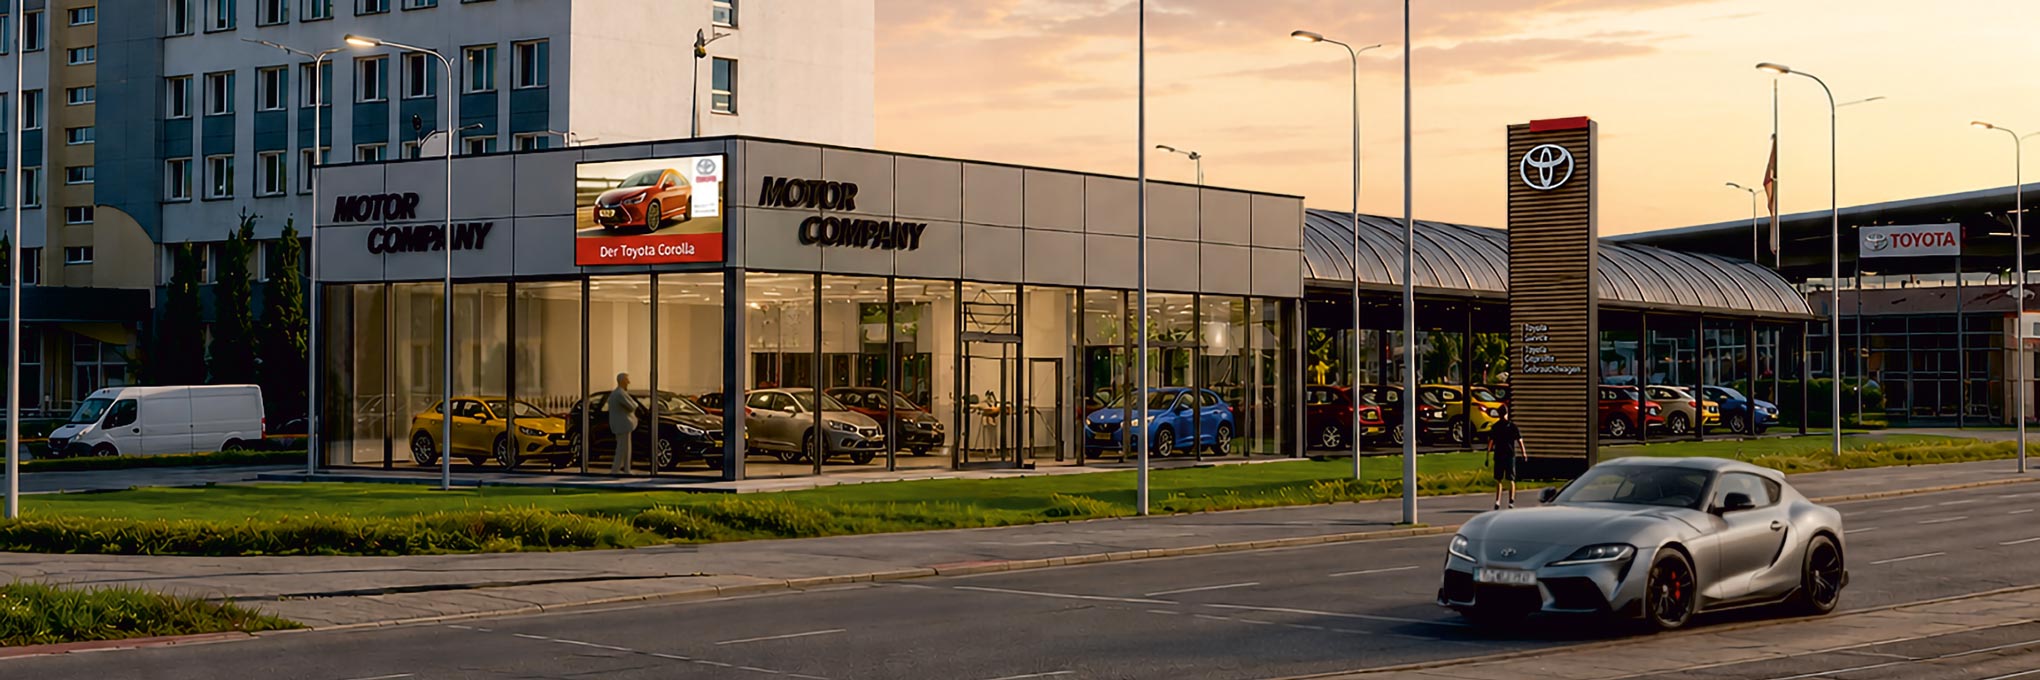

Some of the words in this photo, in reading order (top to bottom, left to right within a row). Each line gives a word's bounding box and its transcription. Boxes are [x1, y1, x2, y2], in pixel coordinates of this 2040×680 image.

[333, 192, 419, 222] MOTOR
[758, 176, 858, 211] MOTOR
[367, 222, 493, 254] COMPANY
[798, 216, 927, 251] COMPANY
[1890, 231, 1956, 248] TOYOTA
[600, 246, 618, 257] Der
[621, 245, 655, 259] Toyota
[658, 242, 695, 256] Corolla
